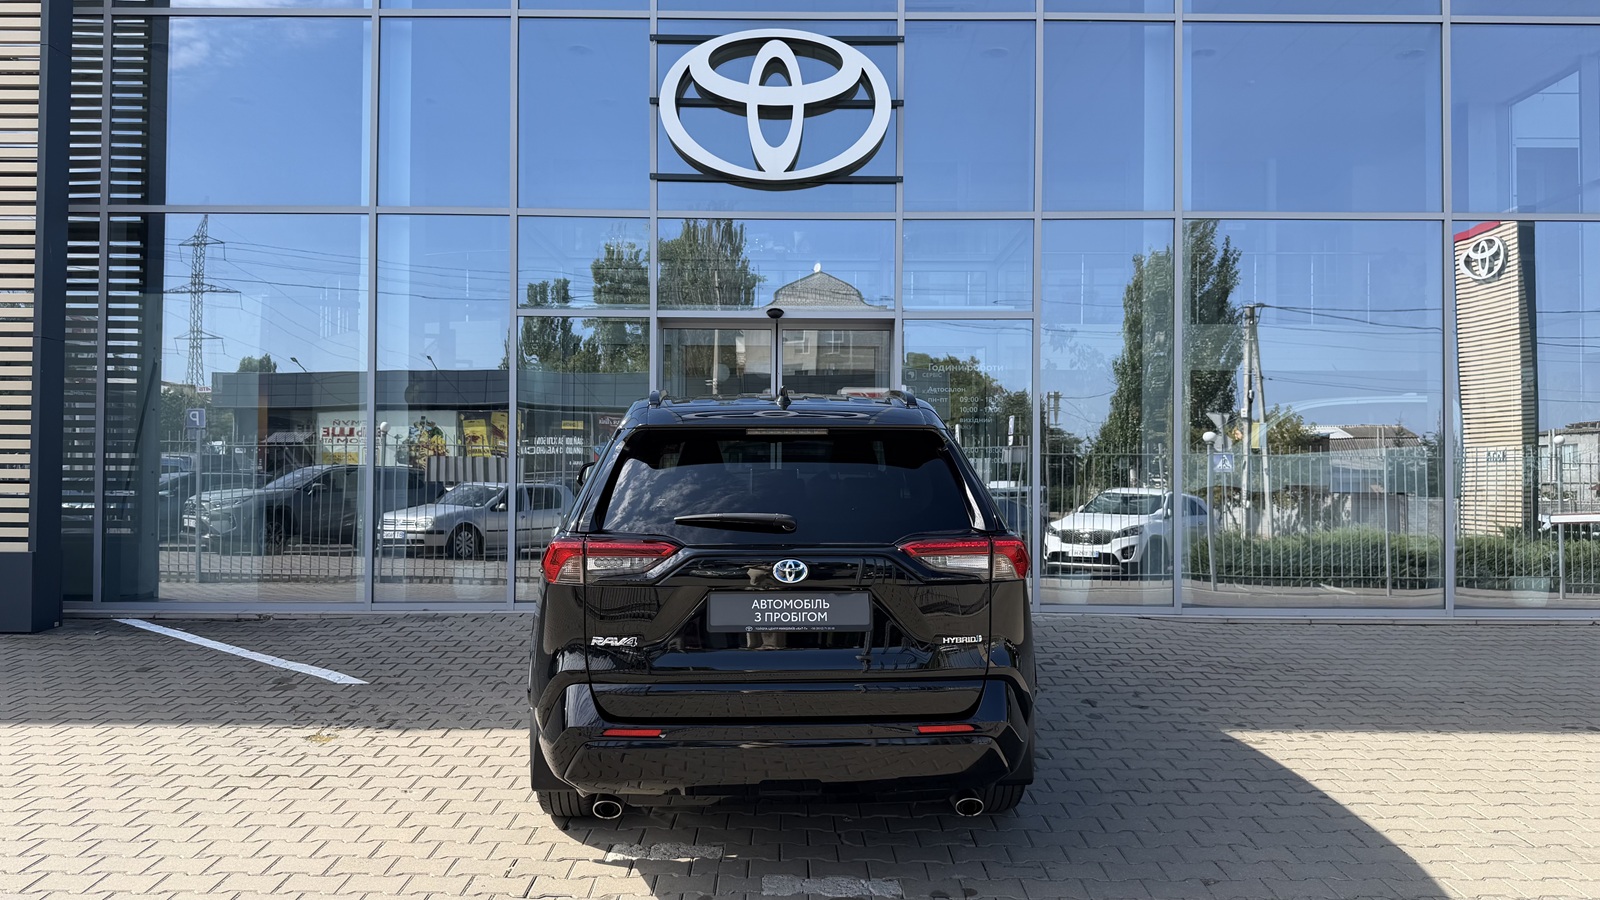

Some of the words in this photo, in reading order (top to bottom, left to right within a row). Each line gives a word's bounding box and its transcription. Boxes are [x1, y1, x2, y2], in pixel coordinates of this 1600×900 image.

[928, 363, 965, 373] Години
[967, 363, 1004, 374] роботи
[751, 599, 830, 609] АВТОМОБІЛЬ
[765, 611, 828, 622] ПРОБІГОМ
[590, 636, 638, 647] RAV4
[942, 636, 976, 644] HYBRID
